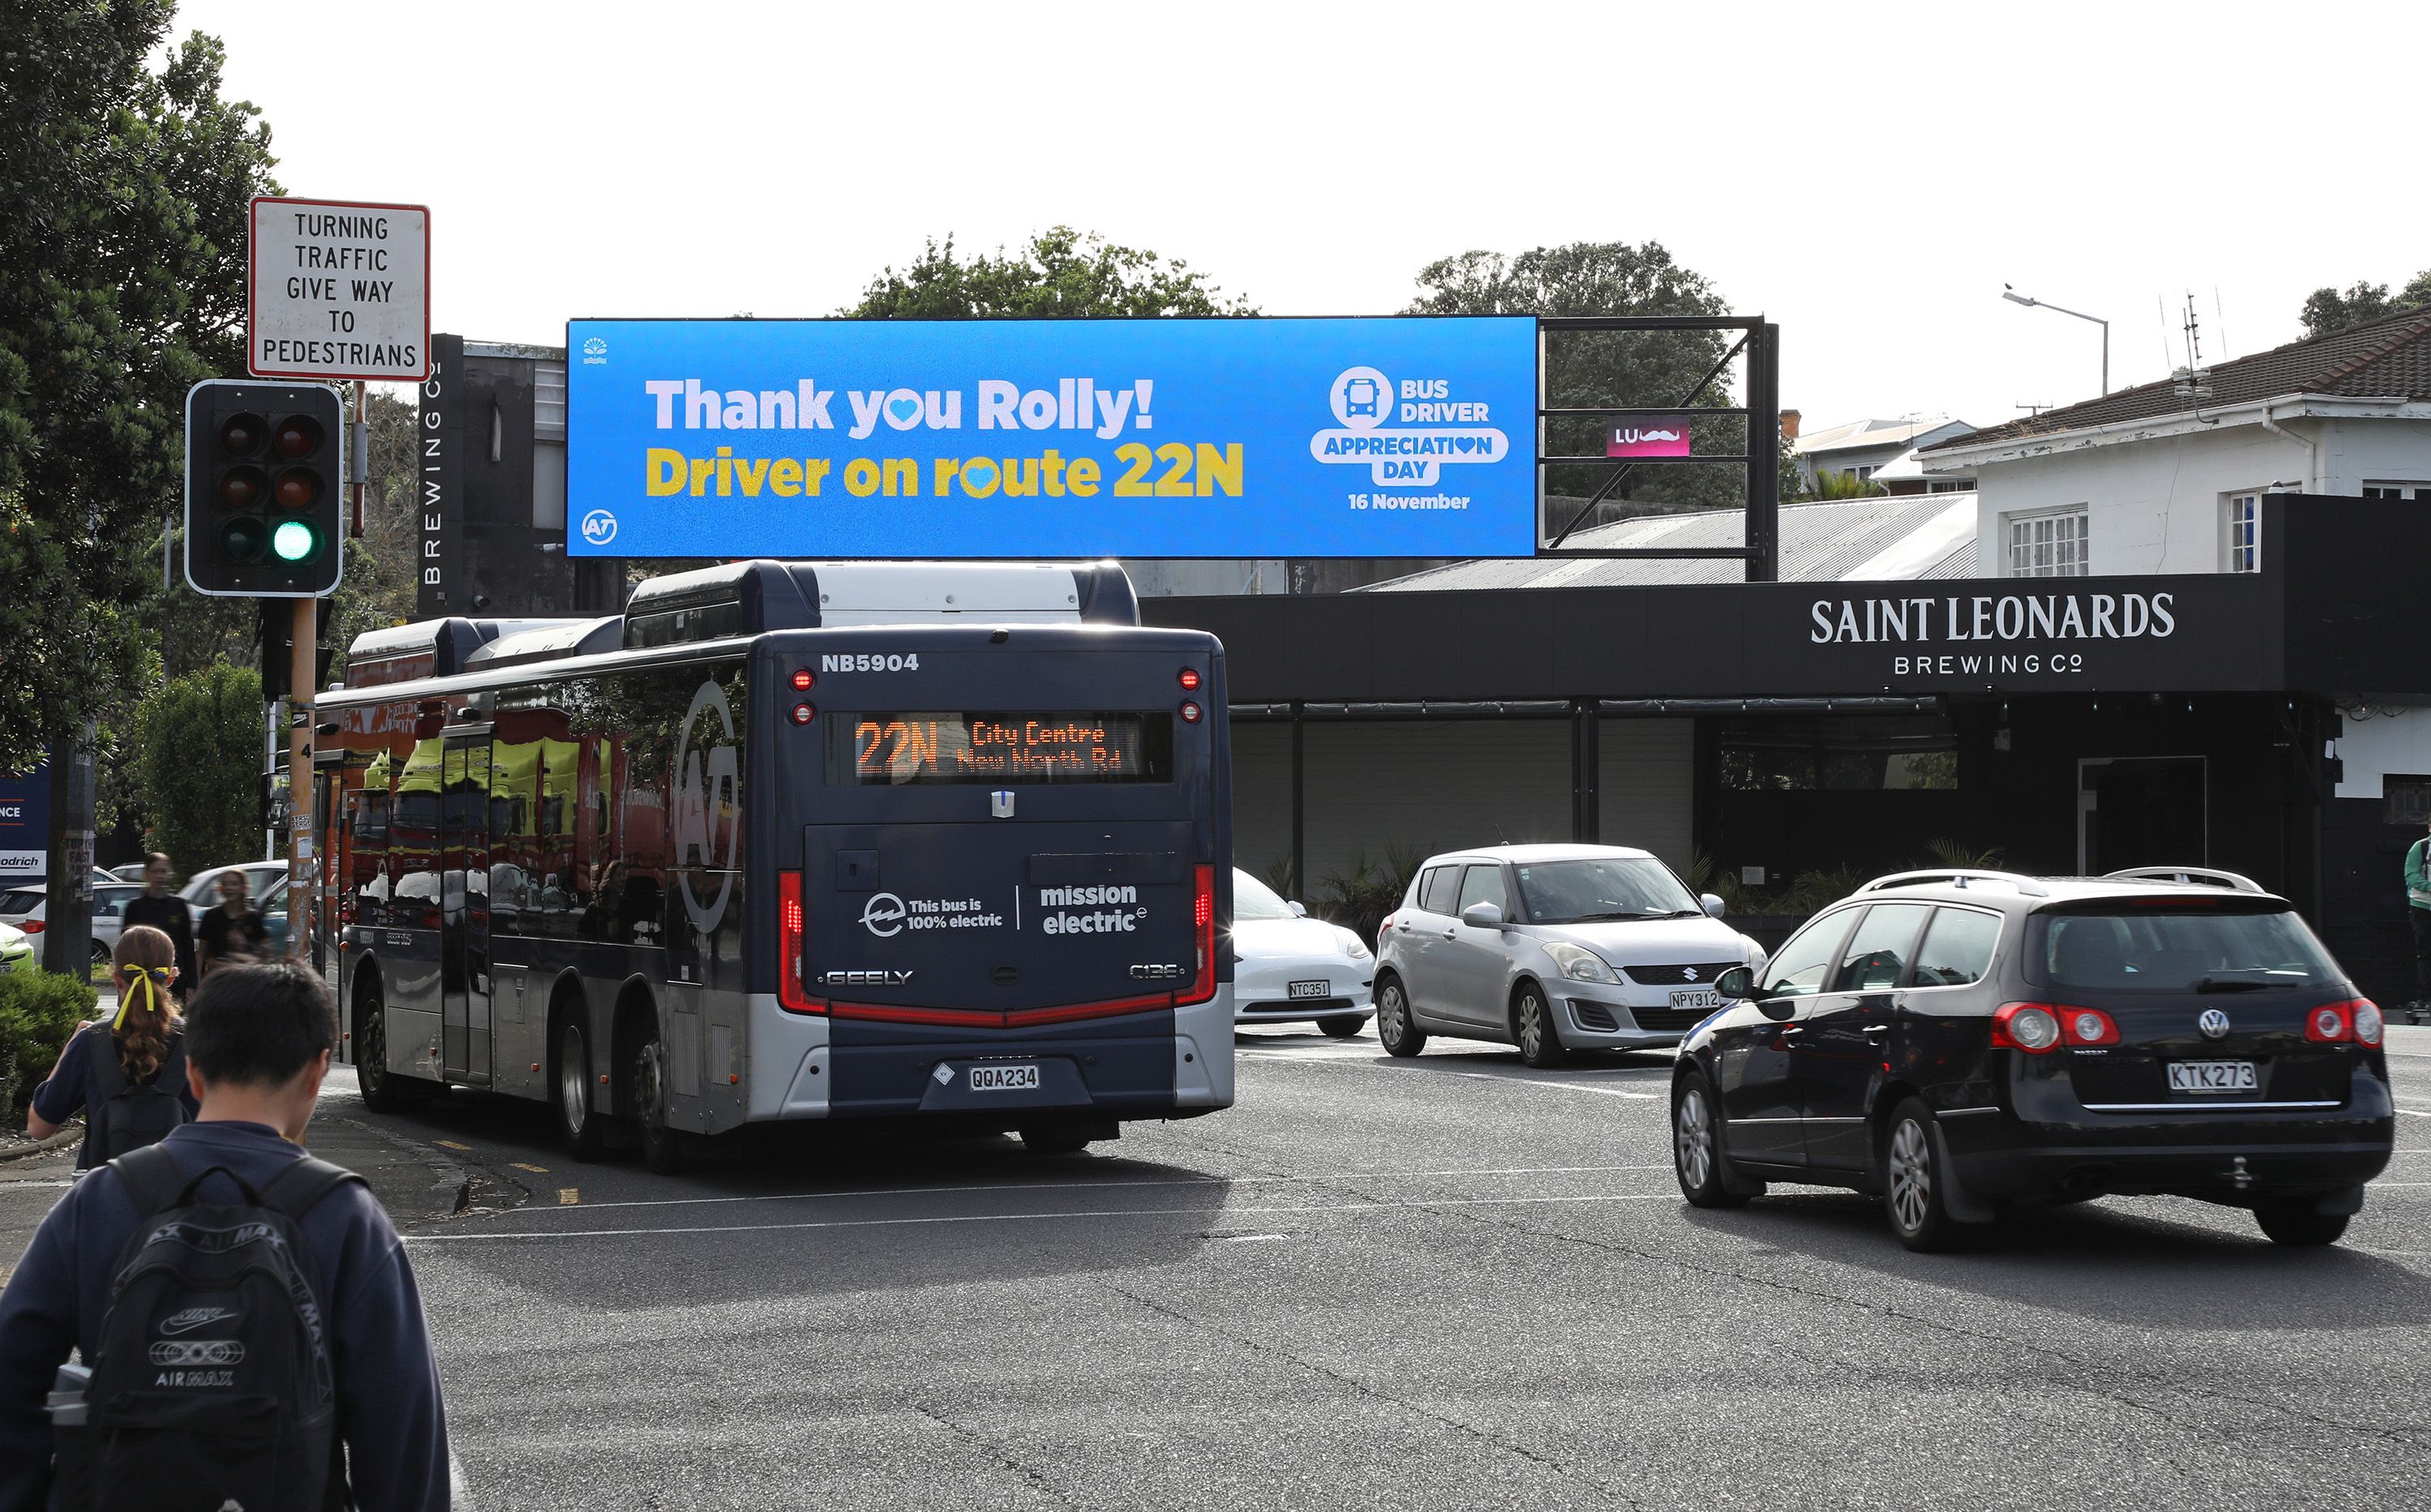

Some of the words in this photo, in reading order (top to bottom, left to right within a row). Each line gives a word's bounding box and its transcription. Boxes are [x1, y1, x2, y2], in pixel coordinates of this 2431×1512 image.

[294, 213, 388, 240] TURNING
[294, 245, 388, 271] TRAFFIC
[287, 276, 336, 301] GIVE
[351, 280, 394, 302] WAY
[328, 310, 355, 332] TO
[263, 339, 417, 367] PEDESTRIANS
[1400, 379, 1449, 399] BUS
[645, 378, 835, 430] Thank
[847, 388, 962, 439] you
[978, 378, 1154, 439] Rolly!
[1400, 402, 1489, 422] DRIVER
[646, 446, 831, 498] Driver
[844, 458, 919, 498] on
[934, 449, 1102, 498] route
[1113, 442, 1244, 498] 22N
[1383, 460, 1429, 479] DAY
[425, 411, 441, 584] BREWING
[1348, 493, 1369, 510] 16
[1372, 493, 1471, 510] November
[1810, 598, 1935, 643] SAINT
[1946, 592, 2176, 640] LEONARDS
[822, 653, 919, 672] NB5904
[1894, 654, 2040, 675] BREWING
[301, 743, 311, 759] 4
[856, 721, 938, 774] 22N
[972, 721, 1018, 746] City
[1025, 720, 1106, 746] Centre
[956, 747, 1005, 772] New
[1011, 747, 1085, 772] North
[1092, 746, 1122, 772] Rd
[0, 856, 39, 866] odrich
[909, 899, 939, 913] This
[941, 899, 968, 912] bus
[969, 899, 981, 911] is
[1040, 885, 1137, 906] mission
[907, 916, 946, 929] 100%
[949, 913, 1003, 928] electric
[1043, 909, 1136, 934] electric
[826, 970, 914, 986] GEELY
[1289, 983, 1327, 996] NTC351
[1672, 993, 1718, 1007] NPY312
[972, 1068, 1036, 1087] QQA234
[2171, 1065, 2254, 1087] KTK273
